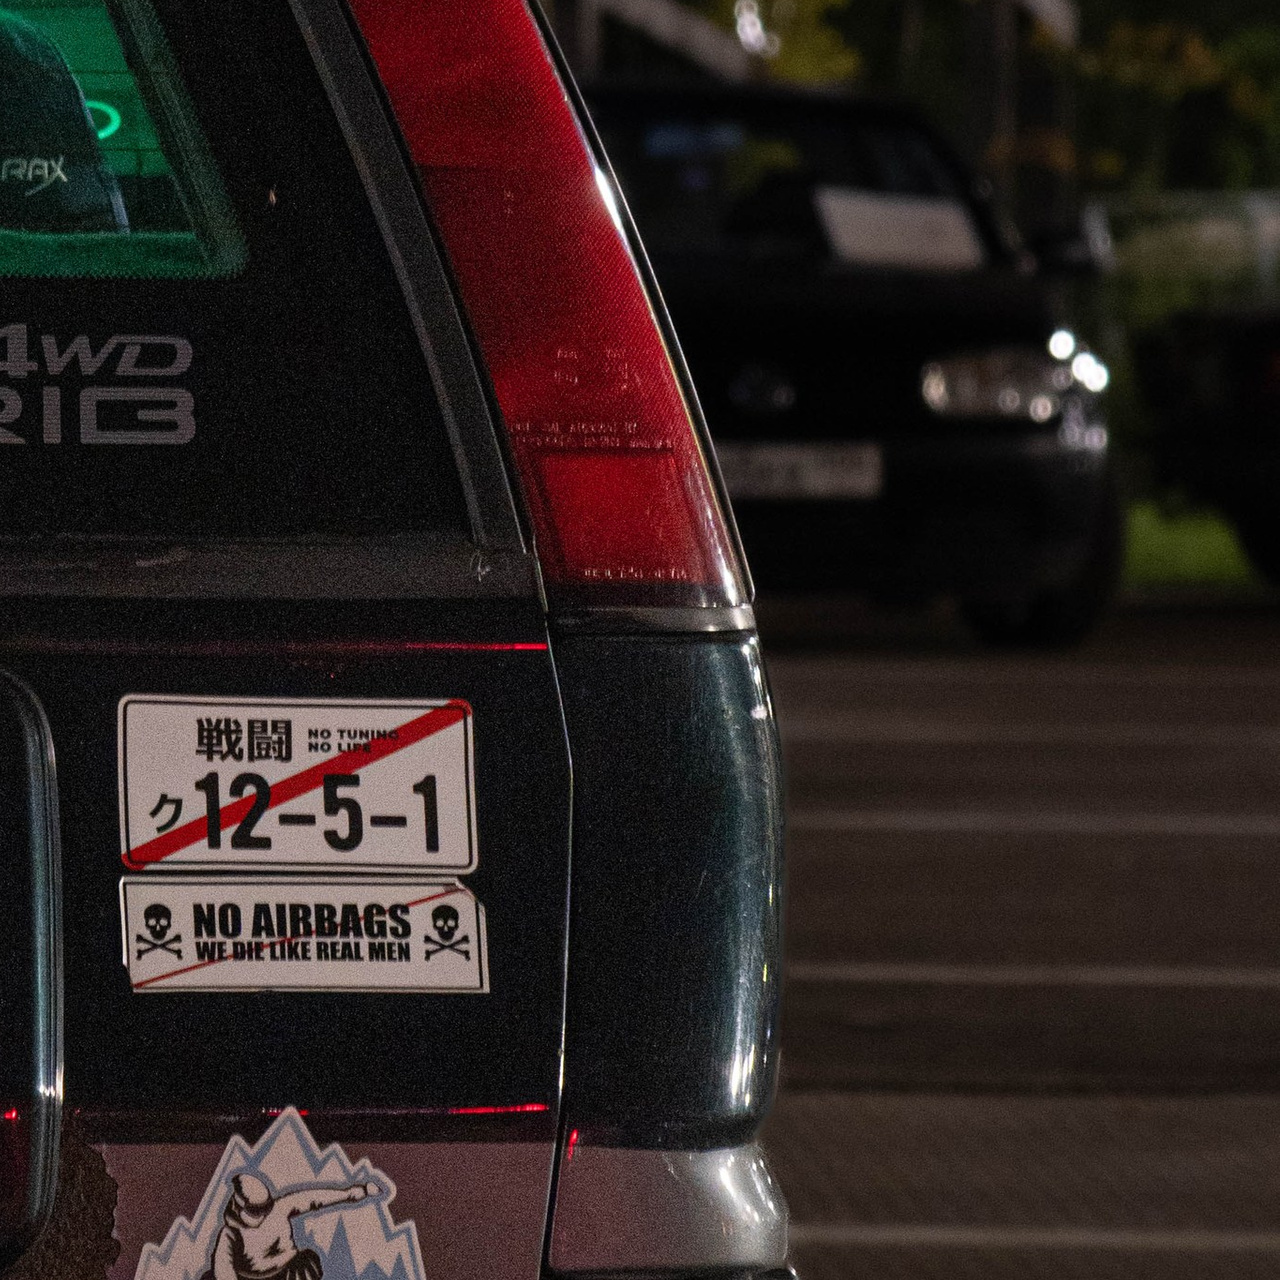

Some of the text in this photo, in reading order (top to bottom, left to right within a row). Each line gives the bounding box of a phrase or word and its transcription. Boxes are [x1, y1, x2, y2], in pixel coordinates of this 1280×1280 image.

[196, 717, 294, 763] 戦闘
[308, 728, 399, 741] NO TUNING
[308, 742, 372, 753] NO LIFE
[149, 793, 183, 834] ク
[194, 771, 440, 854] 12-5-1
[192, 903, 412, 939] NO AIRBAGS
[195, 942, 411, 962] WE DIE LIKE REAL MEN
